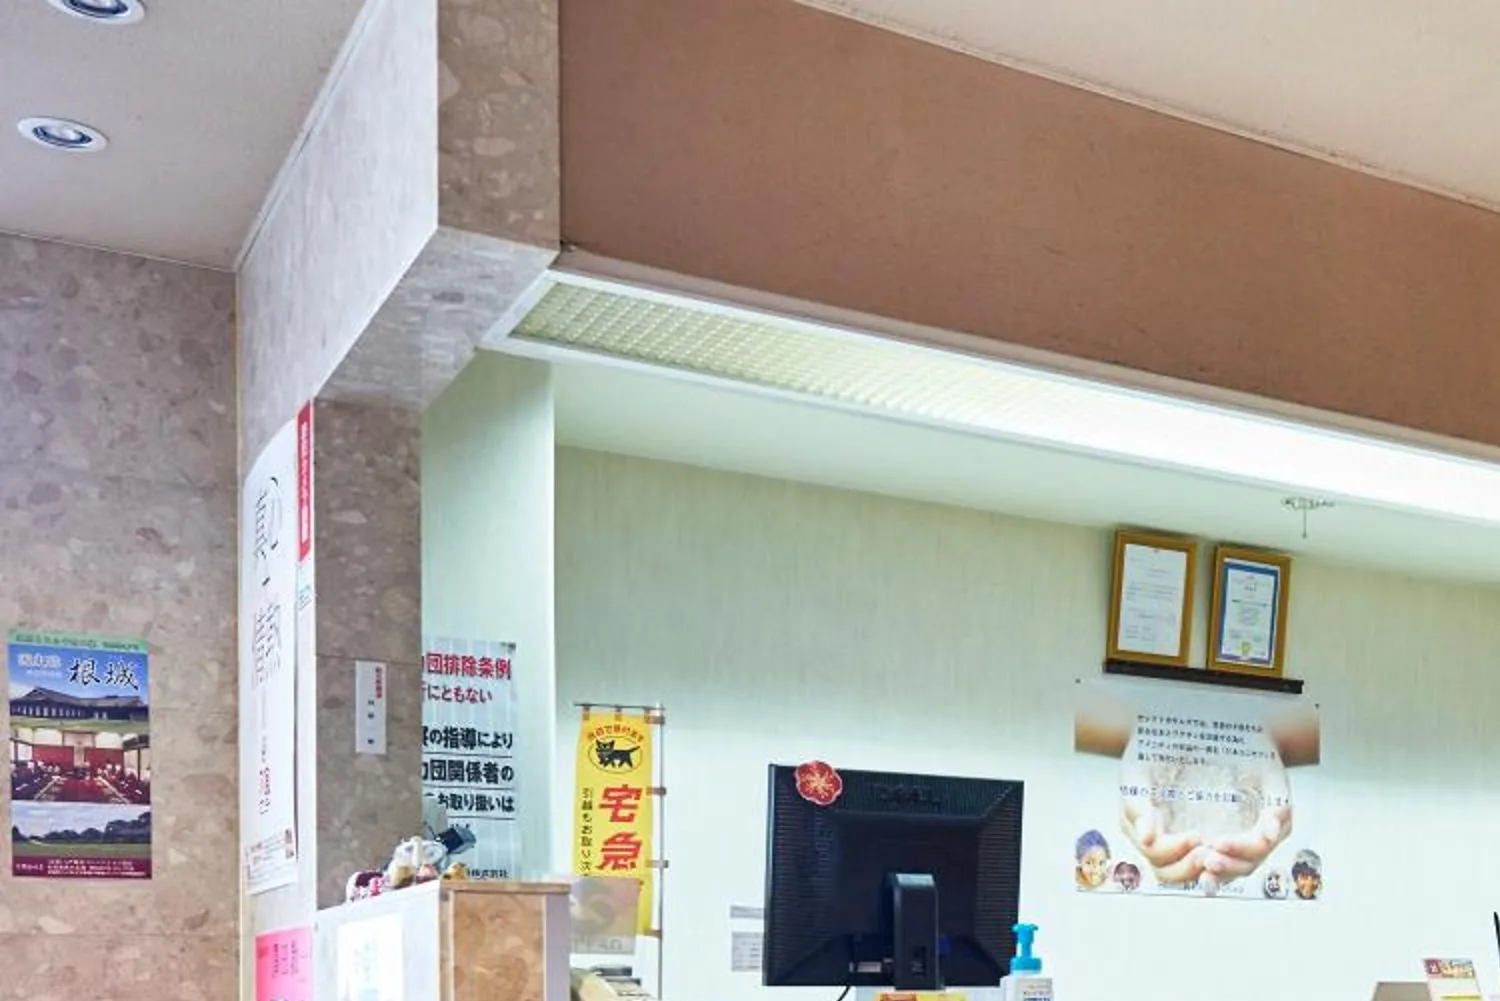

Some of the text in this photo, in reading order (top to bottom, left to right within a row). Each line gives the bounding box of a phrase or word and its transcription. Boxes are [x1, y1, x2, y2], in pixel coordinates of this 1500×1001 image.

[421, 653, 511, 680] 団排除条例
[424, 793, 515, 812] お取り扱いは
[597, 784, 643, 876] 宅急
[578, 787, 594, 877] 引越もお取り次
